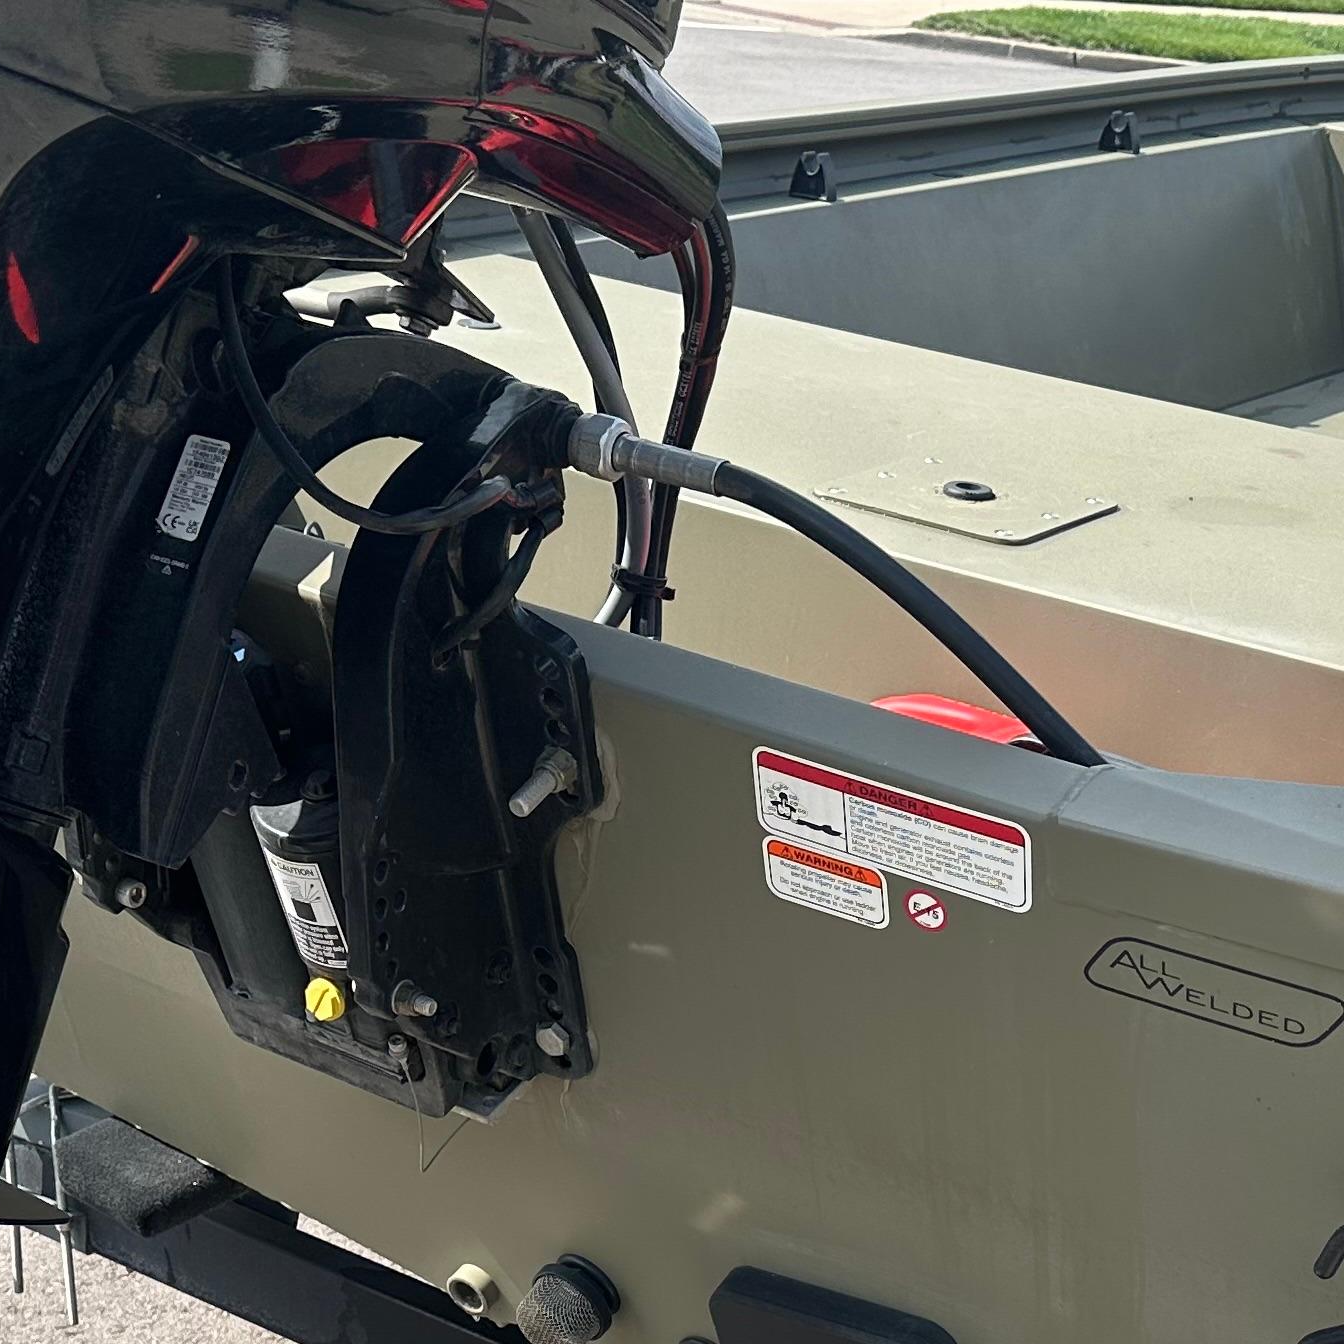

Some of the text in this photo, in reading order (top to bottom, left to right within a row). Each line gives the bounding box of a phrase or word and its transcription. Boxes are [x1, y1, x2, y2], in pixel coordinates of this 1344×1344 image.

[858, 785, 918, 811] DANGER
[793, 849, 853, 876] WARNING
[1109, 949, 1181, 981] ALL
[1138, 966, 1306, 1035] WELDED
